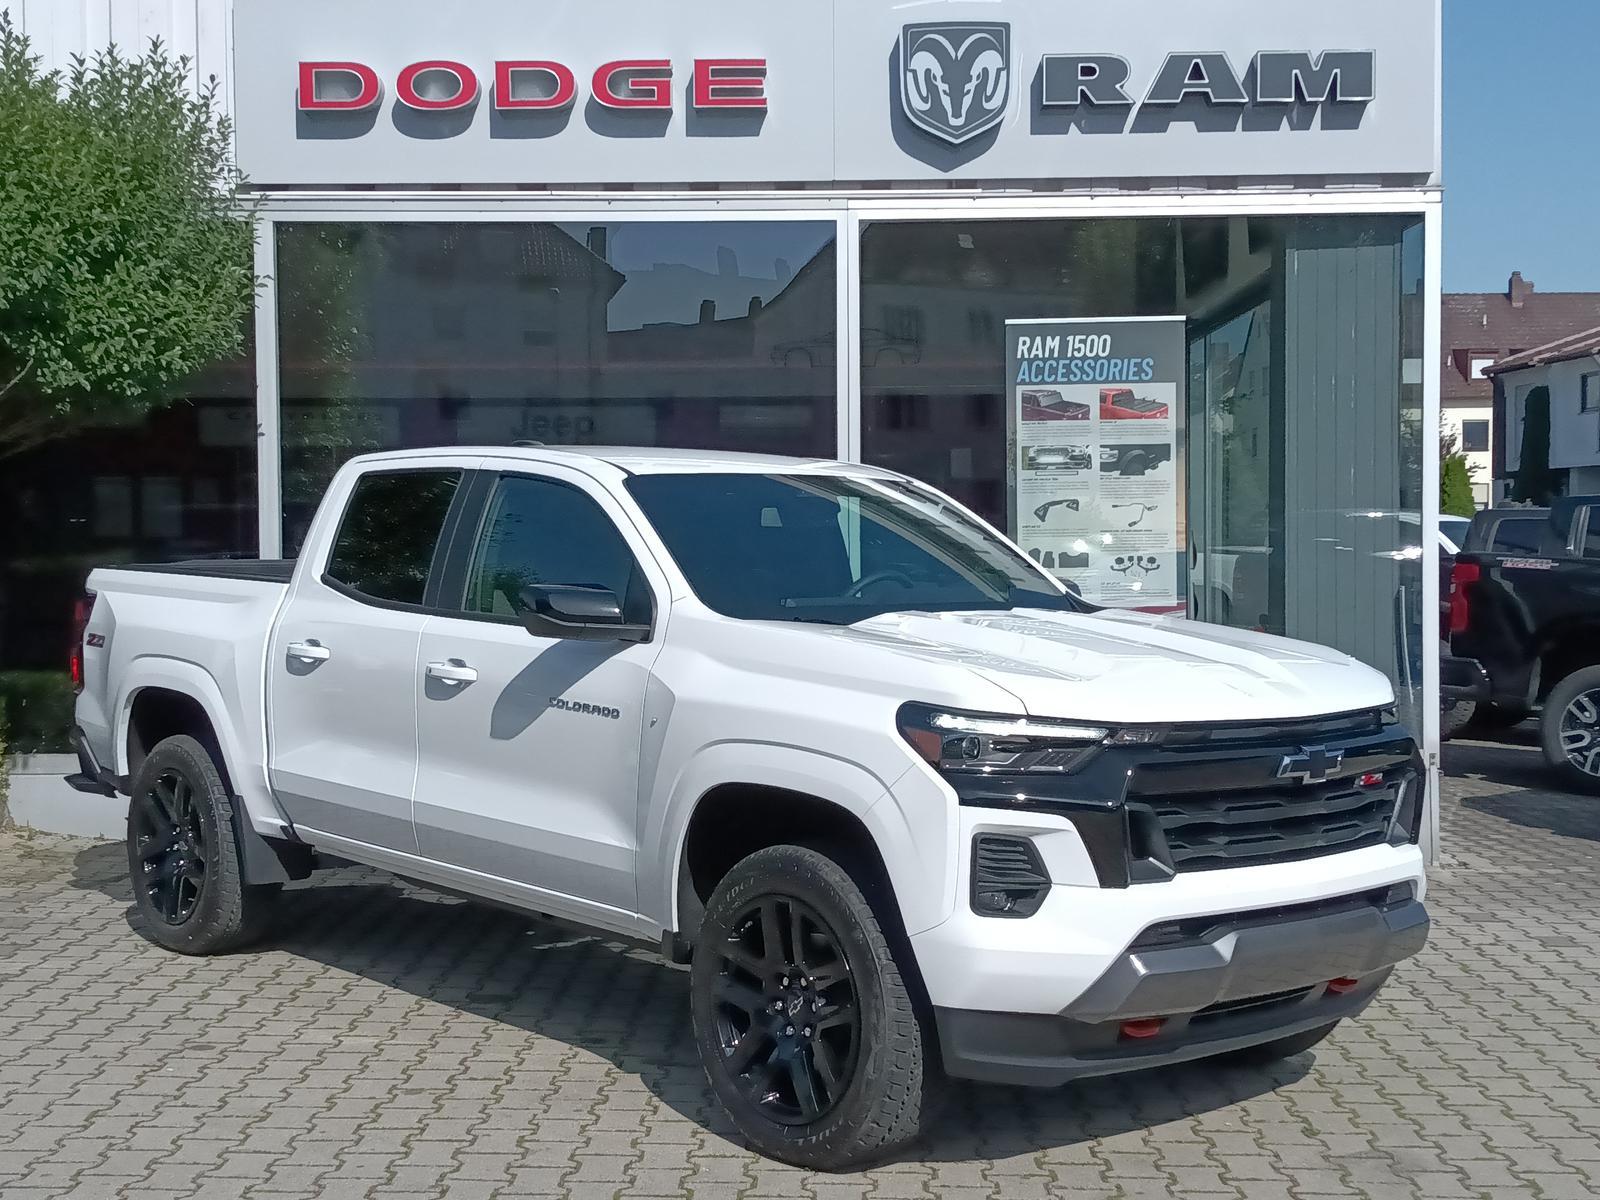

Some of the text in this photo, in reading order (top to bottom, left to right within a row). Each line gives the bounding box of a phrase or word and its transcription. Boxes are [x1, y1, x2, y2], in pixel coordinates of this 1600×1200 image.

[298, 59, 767, 110] DODGE
[1043, 50, 1376, 104] RAM
[1016, 334, 1112, 359] RAM 1500
[1016, 357, 1154, 383] ACCESSORIES
[549, 697, 620, 719] COLORADO
